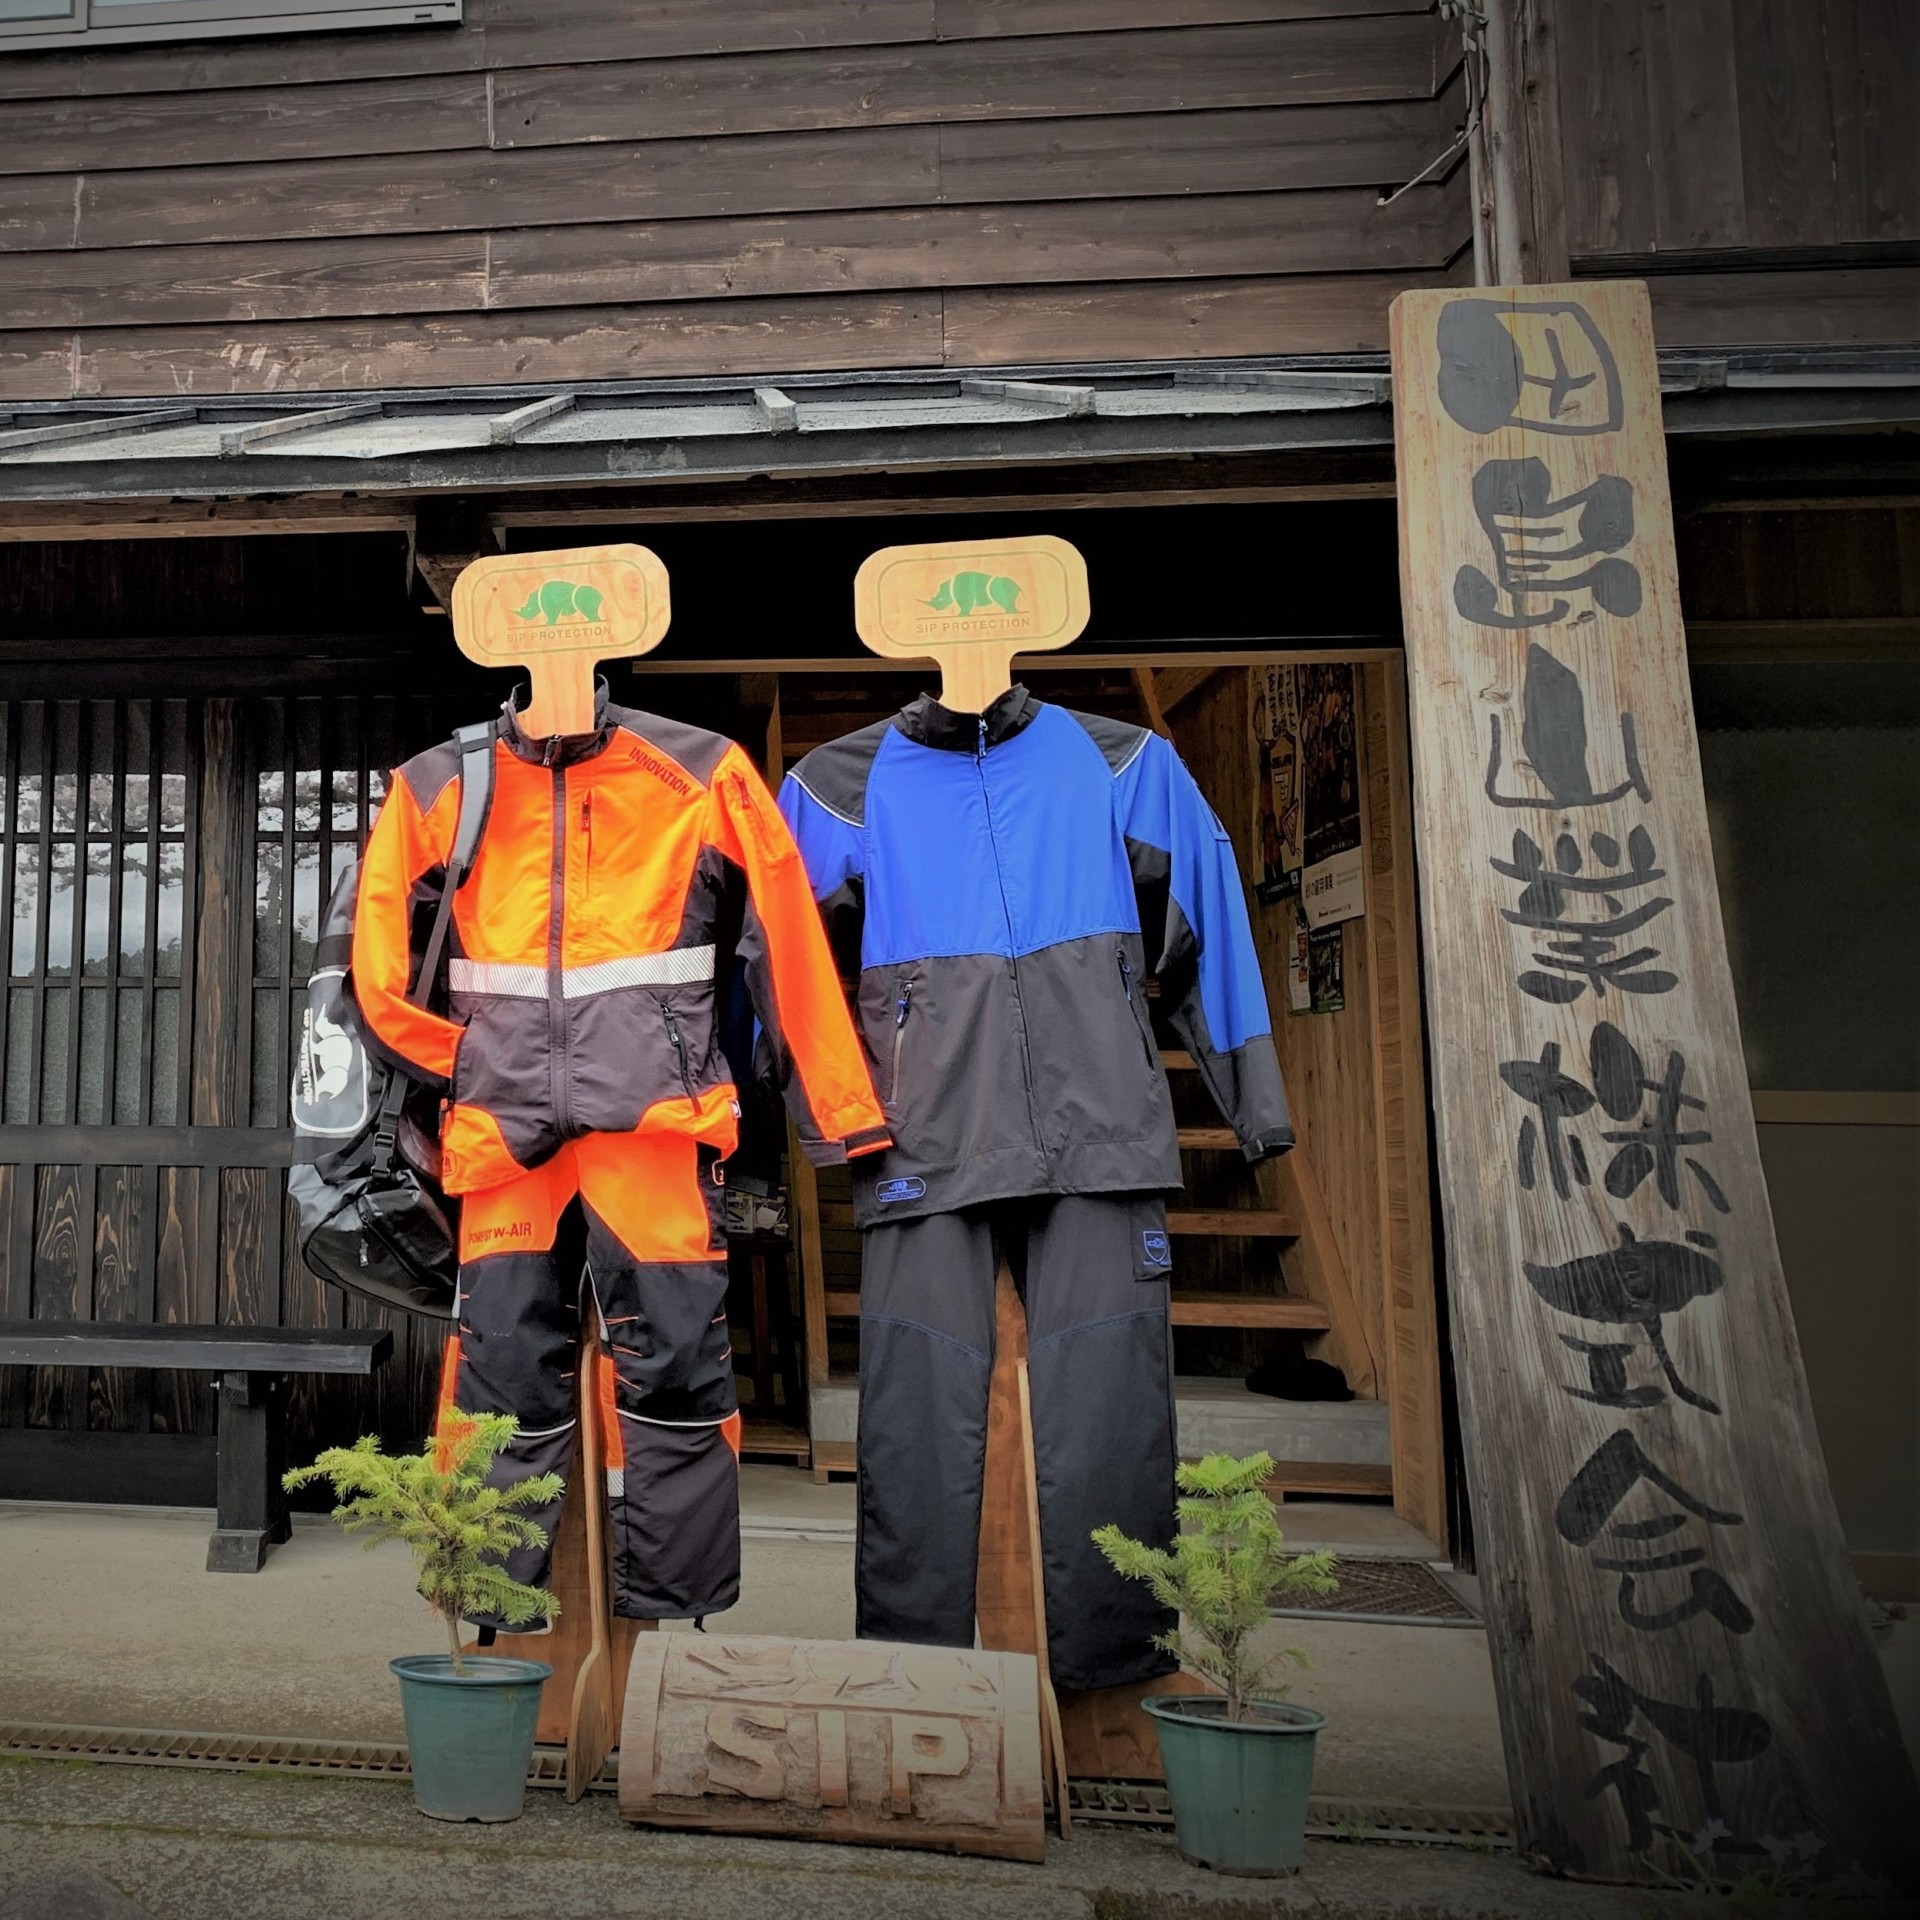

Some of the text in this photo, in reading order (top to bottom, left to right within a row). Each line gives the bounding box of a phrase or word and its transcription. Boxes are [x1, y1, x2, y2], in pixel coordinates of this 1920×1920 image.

[916, 617, 1031, 634] SIP PROTECTION
[507, 626, 612, 643] SIP PROTECTION
[628, 747, 692, 796] INNOVATION
[494, 1222, 532, 1239] W-AIR
[704, 1703, 971, 1816] SIP
